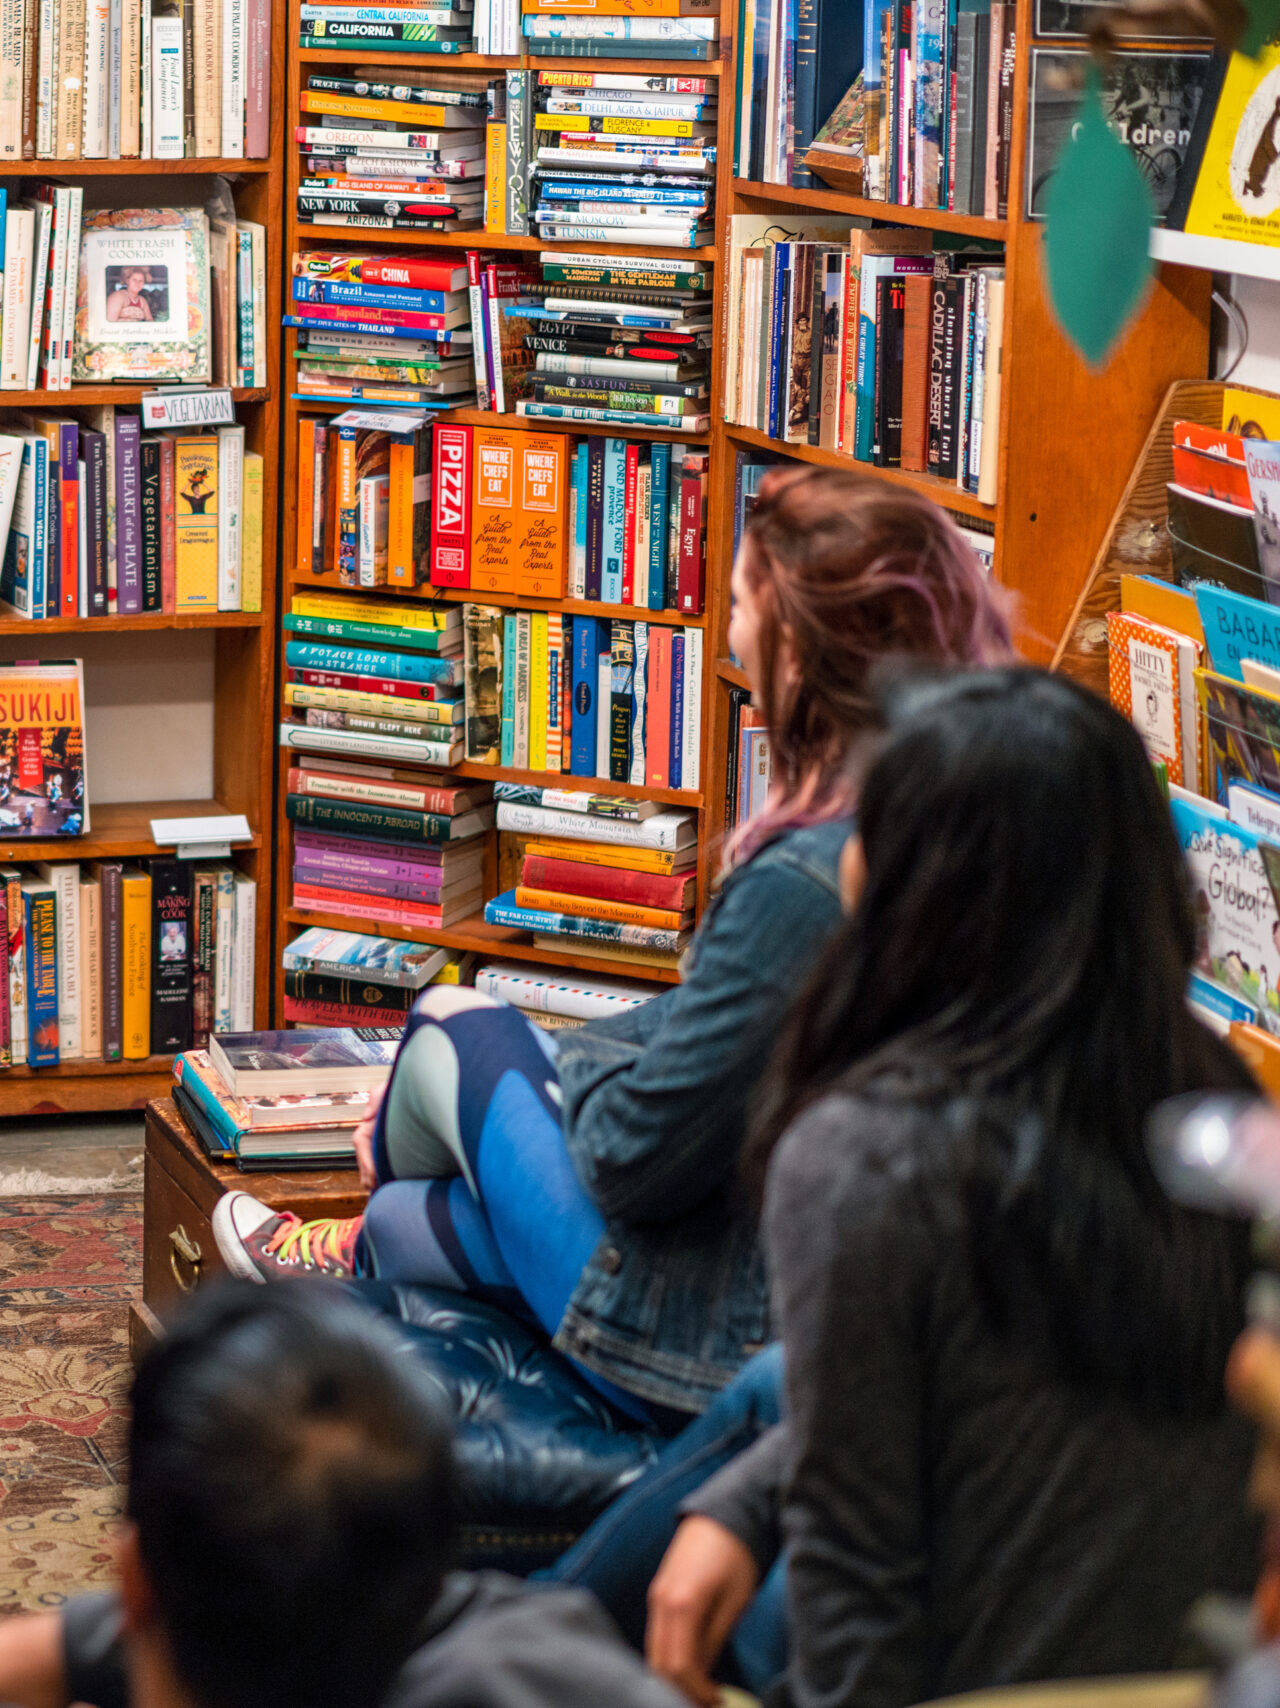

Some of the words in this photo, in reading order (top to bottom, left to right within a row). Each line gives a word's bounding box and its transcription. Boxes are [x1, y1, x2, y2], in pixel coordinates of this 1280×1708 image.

[232, 12, 240, 40] PALATE
[328, 24, 395, 37] CALIFORNIA
[232, 41, 240, 83] COOKBOOK
[542, 73, 571, 85] PUERTO
[572, 74, 592, 86] RICO
[588, 90, 632, 99] CHICAGO
[607, 119, 645, 128] FLORENCE
[607, 126, 642, 134] TUSCANY
[325, 132, 374, 144] OREGON
[508, 110, 524, 158] NEW
[300, 199, 326, 210] NEW
[329, 200, 360, 212] YORK
[582, 202, 634, 214] CRACOW
[346, 216, 388, 227] ARIZONA
[574, 213, 626, 226] MOSCOW
[560, 228, 608, 240] TUNISIA
[381, 268, 410, 284] CHINA
[566, 274, 601, 282] MAUGHAM
[610, 270, 623, 279] THE
[624, 271, 677, 281] GENTLEMAN
[618, 278, 635, 286] THE
[638, 278, 676, 288] PARLOUR
[331, 284, 362, 296] Brazil
[974, 274, 986, 327] COAST
[539, 320, 577, 336] EGYPT
[858, 322, 867, 334] THE
[930, 290, 946, 369] CADILLAC
[525, 337, 568, 352] VENICE
[944, 308, 956, 369] sleeping
[974, 333, 985, 348] OF
[858, 338, 866, 360] GREAT
[858, 362, 866, 387] THIRST
[580, 377, 628, 391] SASTUN
[972, 359, 984, 416] DREAMS
[929, 380, 944, 430] DESERT
[943, 376, 952, 418] where
[164, 394, 229, 423] VEGETARIAN
[124, 448, 133, 464] The
[342, 448, 350, 466] ONE
[482, 450, 510, 464] WHERE
[942, 436, 952, 462] fall
[526, 454, 554, 468] WHERE
[483, 464, 508, 479] CHEFS
[528, 468, 552, 483] CHEFS
[616, 458, 625, 486] FORD
[122, 466, 136, 516] HEART
[342, 469, 350, 502] PEOPLE
[440, 445, 463, 527] PIZZA
[488, 479, 502, 492] EAT
[533, 484, 547, 497] EAT
[48, 478, 57, 512] Ayurveda
[607, 485, 618, 525] provence
[615, 488, 624, 524] MADOX
[125, 516, 133, 526] of
[652, 502, 662, 528] WEST
[36, 520, 44, 550] VEGAN!
[48, 514, 58, 544] Cooking
[126, 528, 134, 542] the
[142, 474, 159, 593] Vegetarianism
[614, 526, 624, 554] FORD
[684, 528, 697, 556] Egypt
[652, 540, 660, 568] NIGHT
[125, 544, 137, 587] PLATE
[298, 646, 306, 655] A
[310, 648, 354, 661] VOYAGE
[356, 652, 387, 664] LONG
[1136, 648, 1164, 673] HITTY
[316, 808, 332, 818] THE
[334, 810, 382, 826] INNOCENTS
[384, 817, 420, 830] ABROAD
[35, 899, 55, 934] PLEASE
[40, 936, 54, 947] TO
[40, 948, 55, 966] THE
[319, 962, 362, 975] AMERICA
[384, 970, 400, 980] AIR
[36, 968, 56, 998] TABLE
